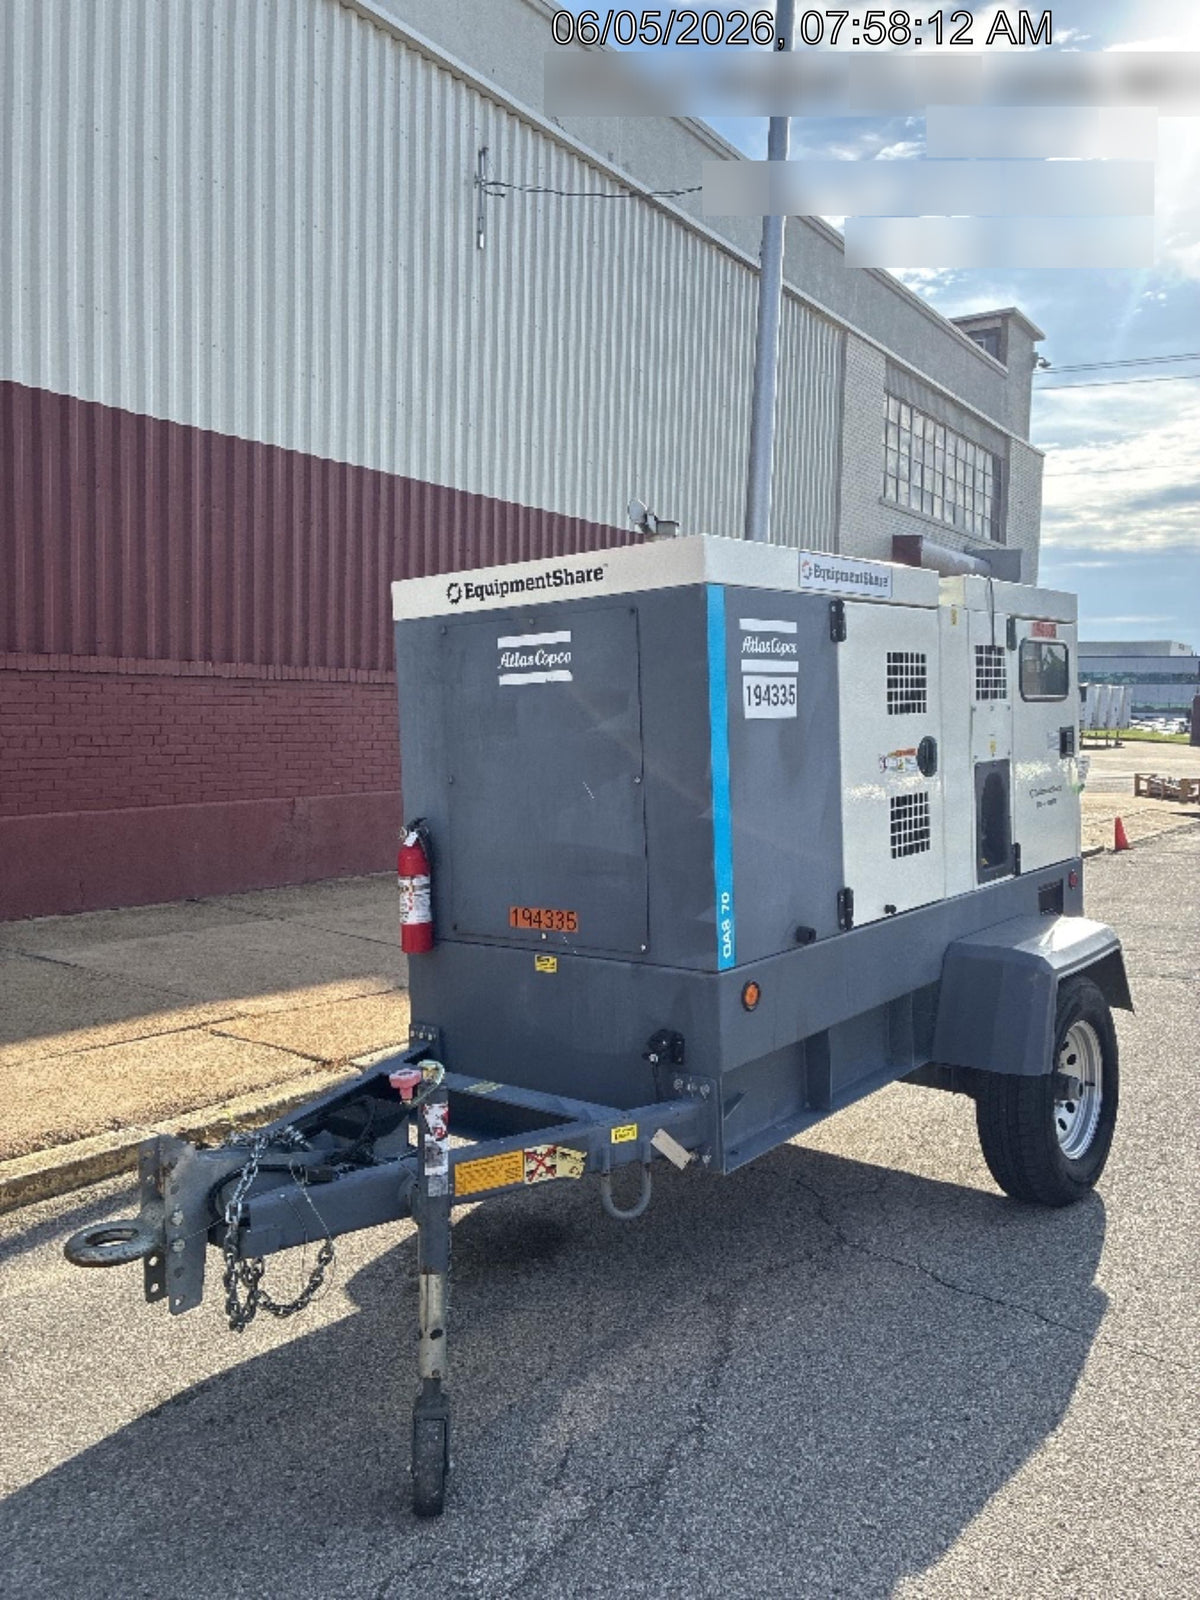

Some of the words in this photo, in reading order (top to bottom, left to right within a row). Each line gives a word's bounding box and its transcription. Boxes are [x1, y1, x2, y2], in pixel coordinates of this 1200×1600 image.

[464, 566, 605, 602] EquipmentShare
[741, 635, 771, 654] Atlas
[497, 651, 534, 670] Atlas
[534, 648, 572, 668] Copco
[745, 683, 797, 707] 194335
[720, 891, 731, 915] 70
[511, 907, 578, 931] 194335
